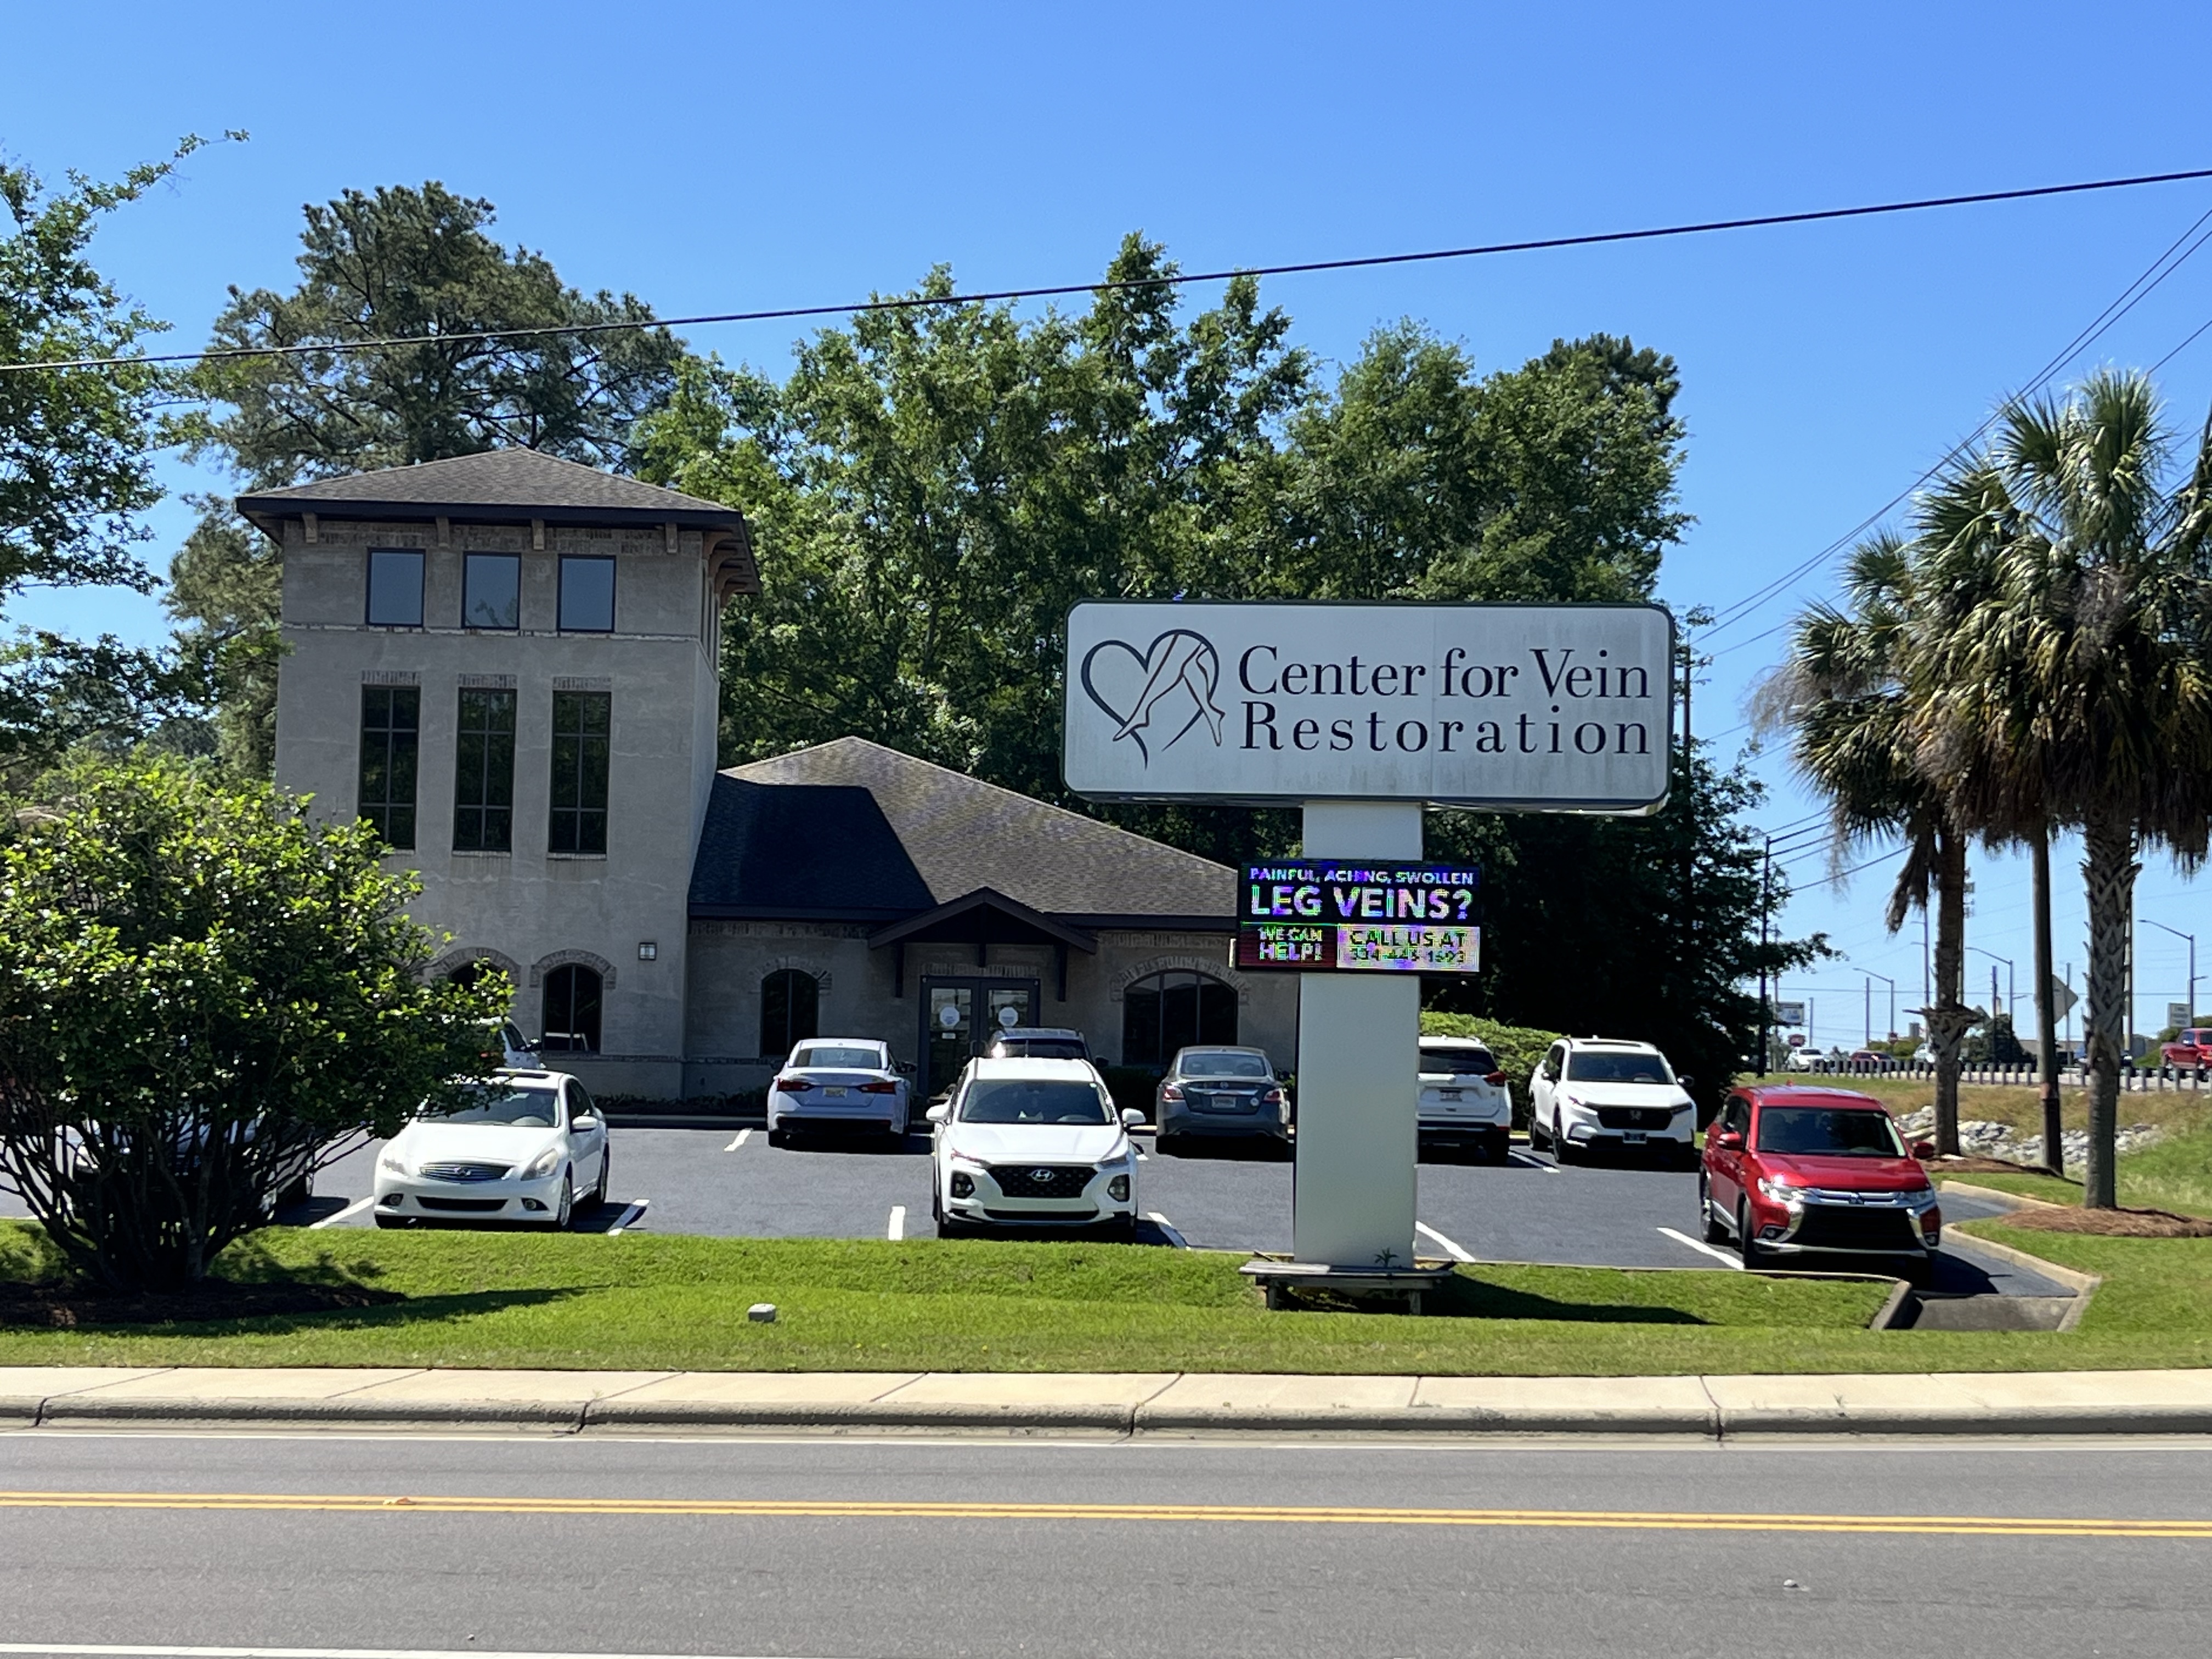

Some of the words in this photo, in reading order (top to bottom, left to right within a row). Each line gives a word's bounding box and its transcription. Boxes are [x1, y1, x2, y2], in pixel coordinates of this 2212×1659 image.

[1239, 645, 1426, 696] Center
[1440, 647, 1519, 697] for
[1529, 648, 1651, 698] Vein
[1239, 701, 1651, 754] Restoration
[1250, 867, 1320, 883] PAINFUL,
[1324, 870, 1392, 884] ACHING,
[1395, 871, 1474, 885] SWOLLEN
[1251, 884, 1323, 916] LEG
[1333, 887, 1472, 919] VEINS?
[1258, 927, 1284, 941] WE
[1350, 930, 1401, 946] CALL
[1408, 931, 1434, 947] US
[1440, 932, 1468, 947] AT
[1259, 942, 1323, 962] HELP!
